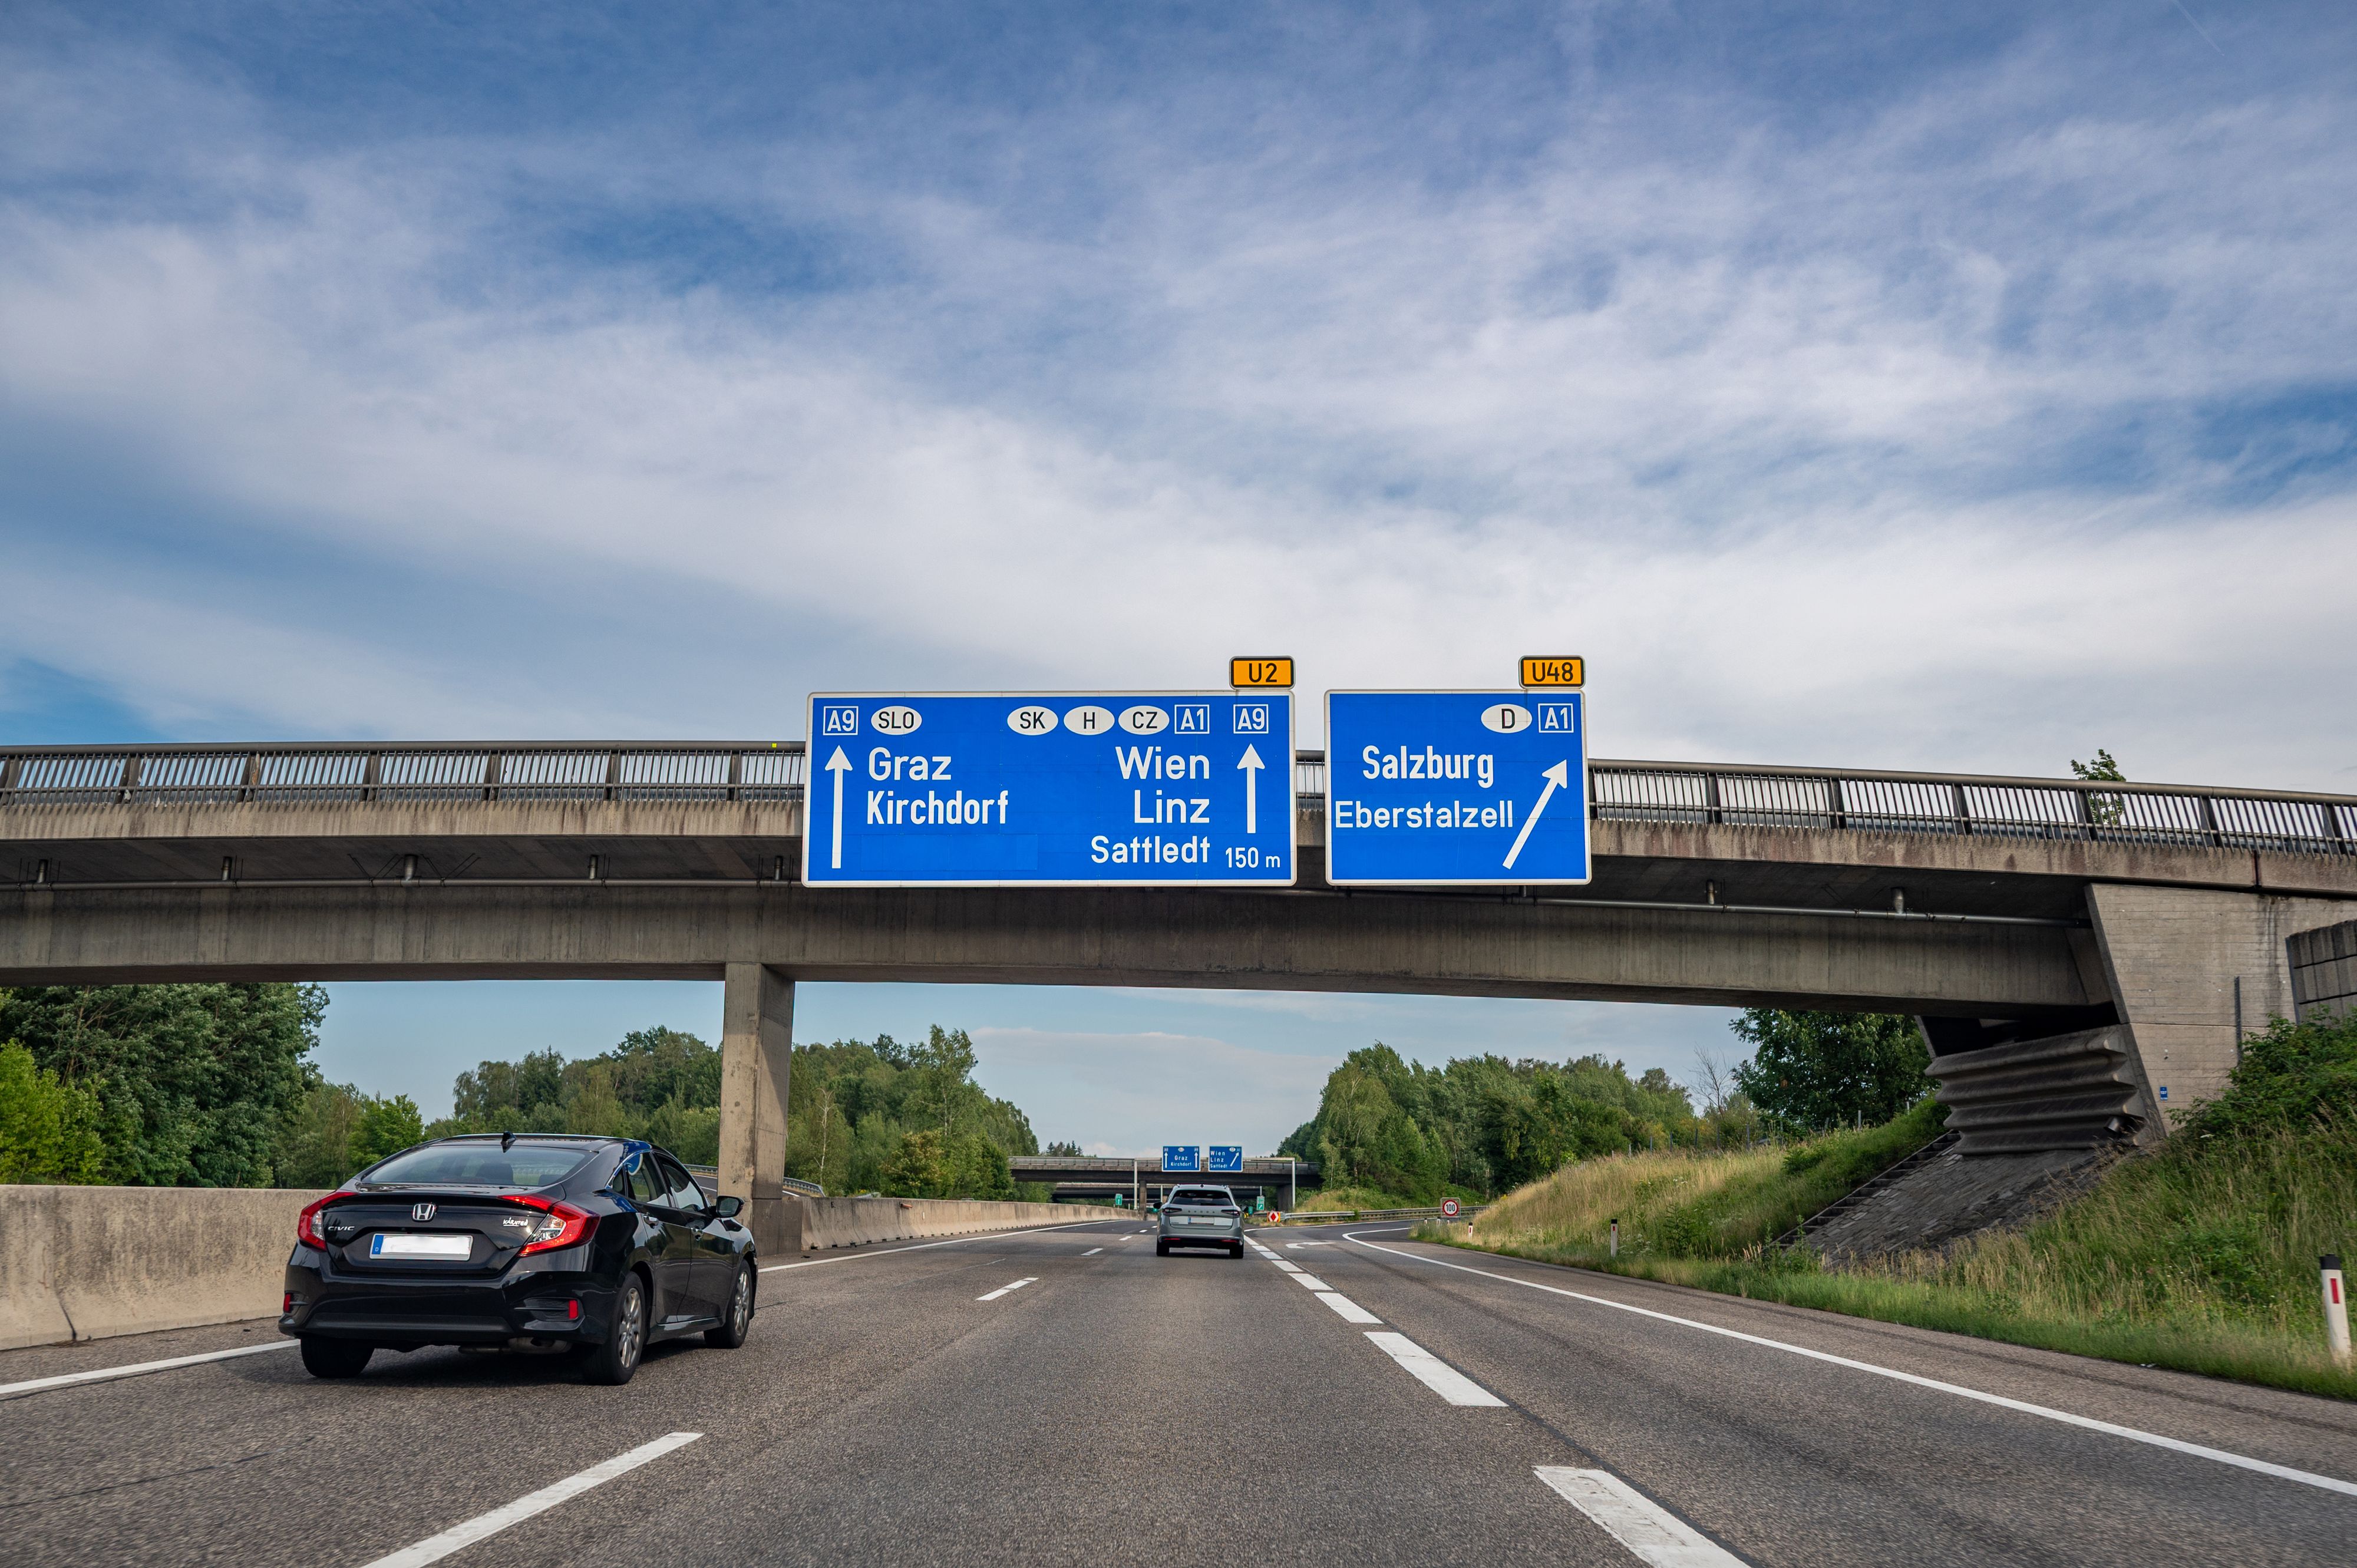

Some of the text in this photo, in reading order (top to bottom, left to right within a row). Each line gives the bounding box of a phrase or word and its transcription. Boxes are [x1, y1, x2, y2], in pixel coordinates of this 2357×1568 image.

[1249, 662, 1277, 683] U2
[1532, 662, 1573, 682] U48
[827, 709, 915, 732] A9 SLO
[1020, 708, 1204, 730] SK H CZ A1
[1239, 708, 1265, 730] A9
[1501, 707, 1569, 729] D A1
[869, 747, 952, 781] Graz
[1115, 746, 1210, 780] Wien
[1362, 745, 1494, 788] Salzburg
[867, 790, 1008, 824] Kirchdorf
[1134, 790, 1210, 823] Linz
[1335, 800, 1513, 828] Eberstalzell
[1091, 835, 1210, 863] Sattledt
[1226, 847, 1280, 868] 150 m
